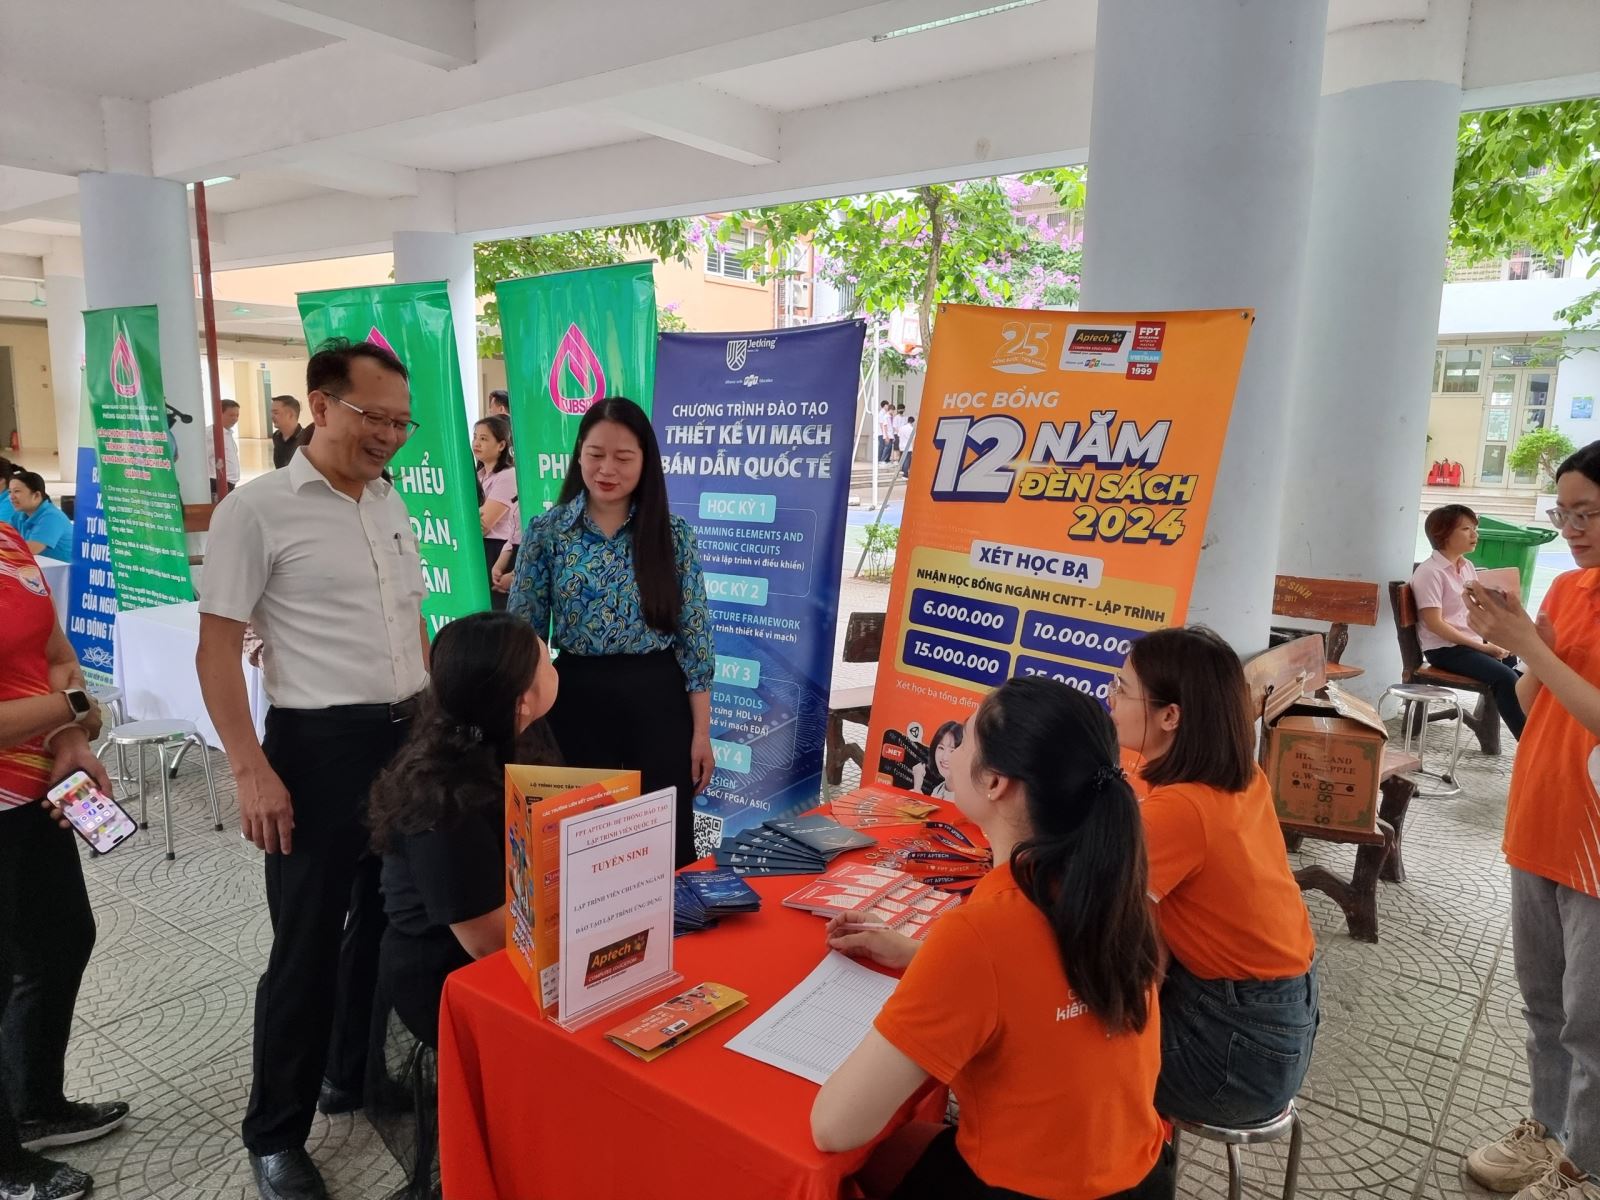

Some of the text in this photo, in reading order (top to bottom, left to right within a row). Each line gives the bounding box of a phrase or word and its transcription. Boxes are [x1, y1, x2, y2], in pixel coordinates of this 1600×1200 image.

[1076, 333, 1110, 343] Aptech
[1139, 327, 1161, 336] FPT
[1131, 367, 1153, 375] 1999
[672, 400, 829, 419] CHƯƠNG TRÌNH ĐÀO TẠO
[942, 385, 1060, 414] HỌC BỔNG
[665, 418, 832, 451] THIẾT KẾ VI MẠCH
[661, 448, 833, 480] BÁN DẪN QUỐC TẾ
[931, 410, 1173, 503] 12 NĂM
[401, 451, 445, 495] HIỂU
[1018, 466, 1198, 505] ĐÈN SÁCH
[707, 498, 766, 518] HỌC KỲ 1
[692, 525, 804, 543] RAMMING ELEMENTS AND
[1068, 505, 1187, 544] 2024
[697, 540, 781, 556] ECTRONIC CIRCUITS
[754, 558, 761, 566] vi
[979, 546, 1089, 584] XÉT HỌC BẠ
[420, 559, 452, 594] ÂM
[730, 580, 749, 598] KỲ
[751, 584, 759, 599] 2
[917, 568, 947, 584] NHẬN
[948, 575, 969, 589] HỌC
[971, 577, 1003, 593] BỔNG
[1004, 584, 1050, 602] NGÀNH
[1052, 593, 1086, 608] CNTT
[1095, 600, 1121, 616] LẬP
[1124, 605, 1166, 623] TRÌNH
[82, 589, 98, 612] CỦA
[71, 616, 107, 640] LAO ĐỘNG
[709, 609, 801, 630] ECTURE FRAMEWORK
[923, 600, 1132, 655] 6.000.000 10.000.00
[914, 640, 1000, 674] 15.000.000
[722, 662, 751, 682] KỲ 3
[896, 679, 911, 691] Xét
[713, 692, 763, 710] EDA TOOLS
[736, 709, 752, 720] HDL
[753, 713, 763, 723] và
[720, 719, 728, 728] vi
[750, 725, 769, 737] EDA)
[734, 750, 743, 765] 4
[710, 775, 737, 790] ESIGN
[750, 798, 771, 812] ASIC)
[575, 830, 586, 838] FPT
[627, 846, 649, 862] SINH
[591, 943, 631, 968] Aptech
